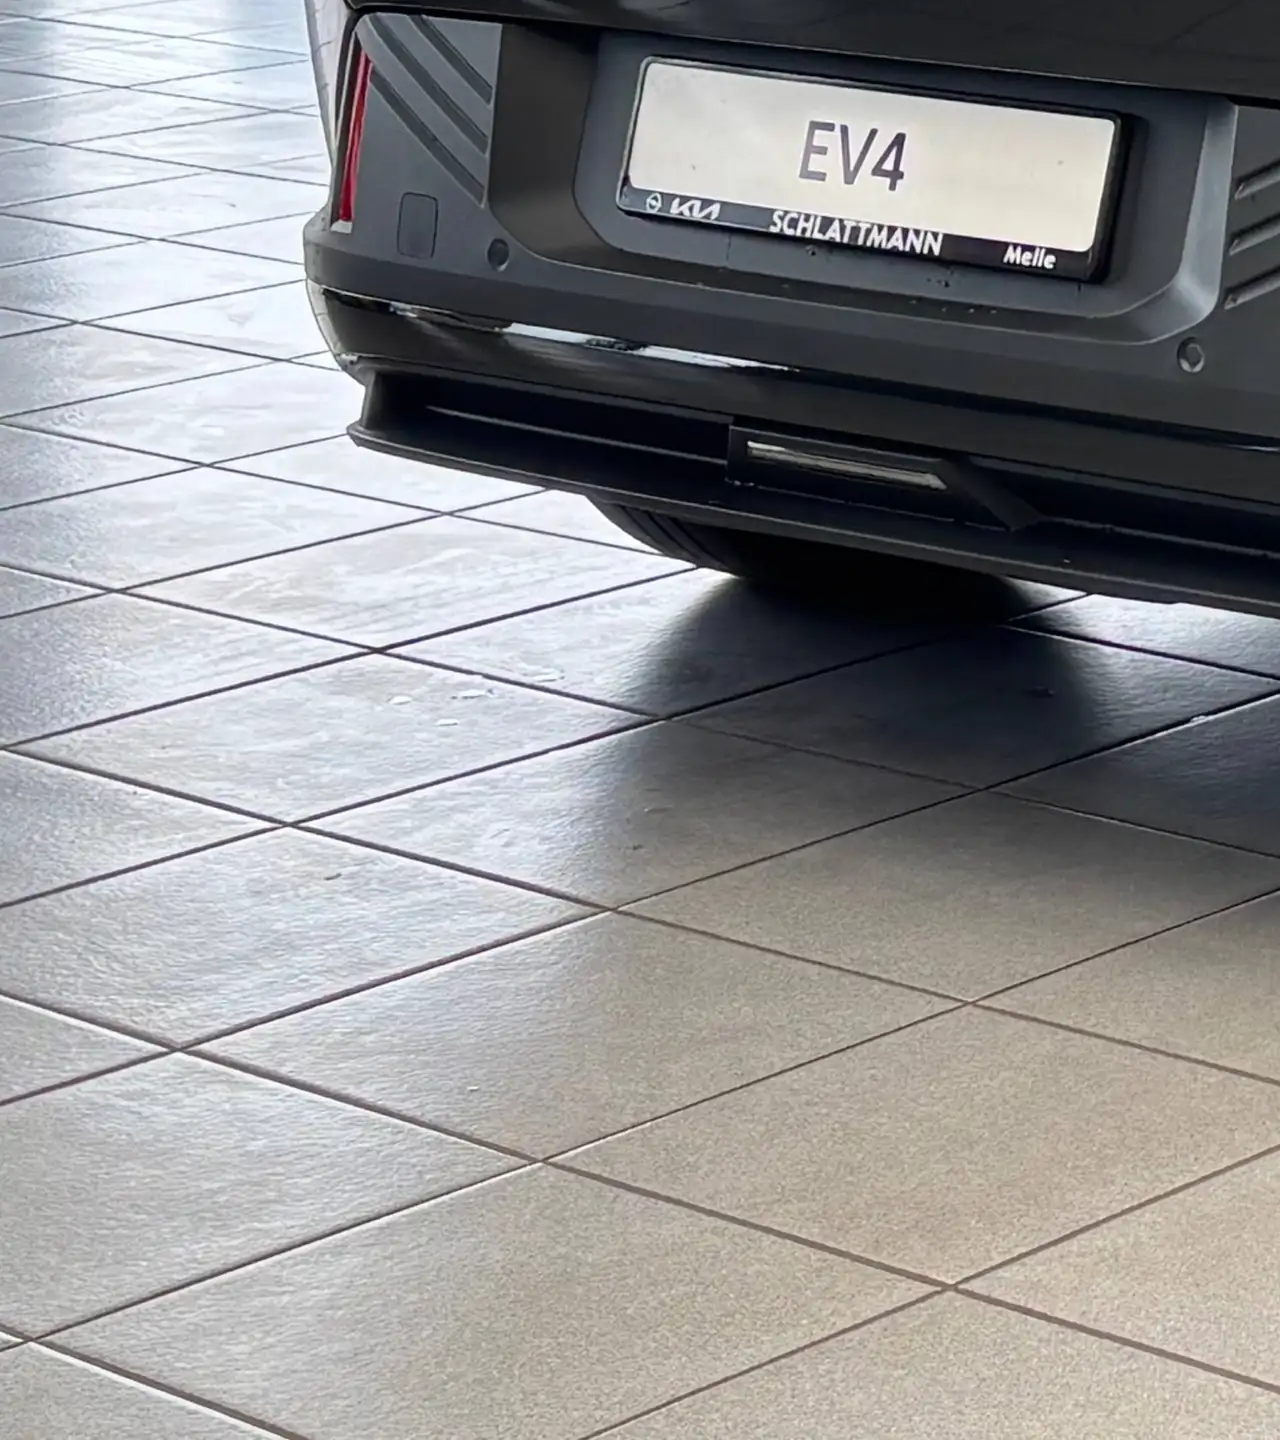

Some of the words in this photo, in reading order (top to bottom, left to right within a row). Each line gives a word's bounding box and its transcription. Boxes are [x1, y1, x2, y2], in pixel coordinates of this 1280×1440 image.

[798, 119, 907, 192] EV4
[669, 196, 721, 221] KIA
[769, 209, 944, 257] SCHLATTMANN
[1003, 243, 1056, 270] Melle
